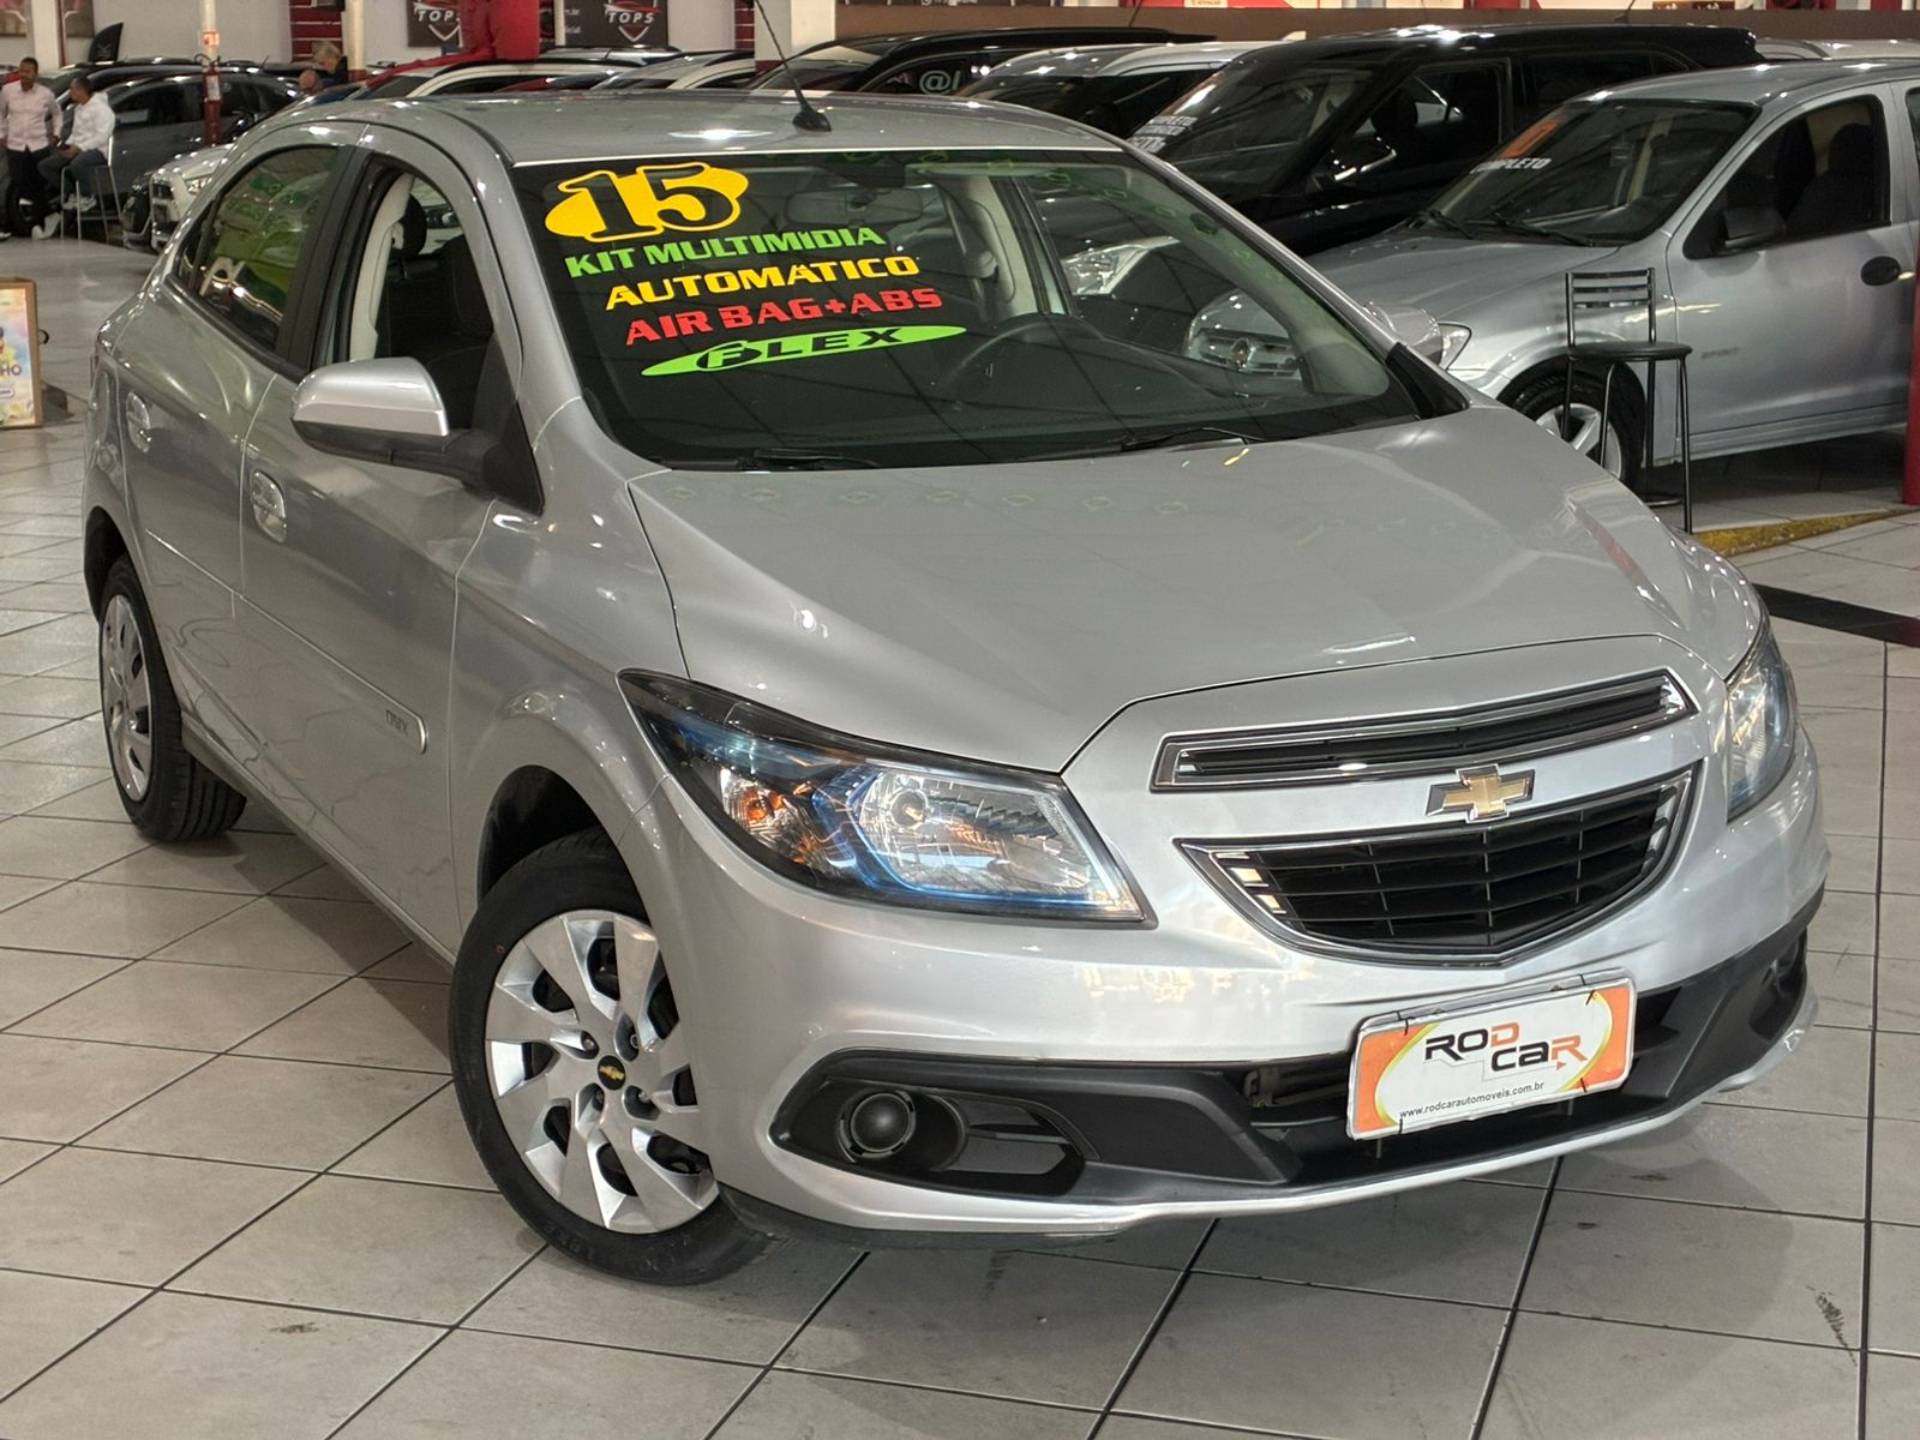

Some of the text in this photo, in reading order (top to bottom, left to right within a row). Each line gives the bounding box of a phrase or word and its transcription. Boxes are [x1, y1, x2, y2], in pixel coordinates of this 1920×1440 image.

[607, 12, 655, 24] TOPS
[557, 162, 741, 243] 15
[564, 247, 636, 279] KIT
[626, 287, 944, 346] AIR BAG+ABS
[697, 328, 905, 372] FLEX
[1399, 1081, 1545, 1119] www.rodcarautomoveis.com.br
